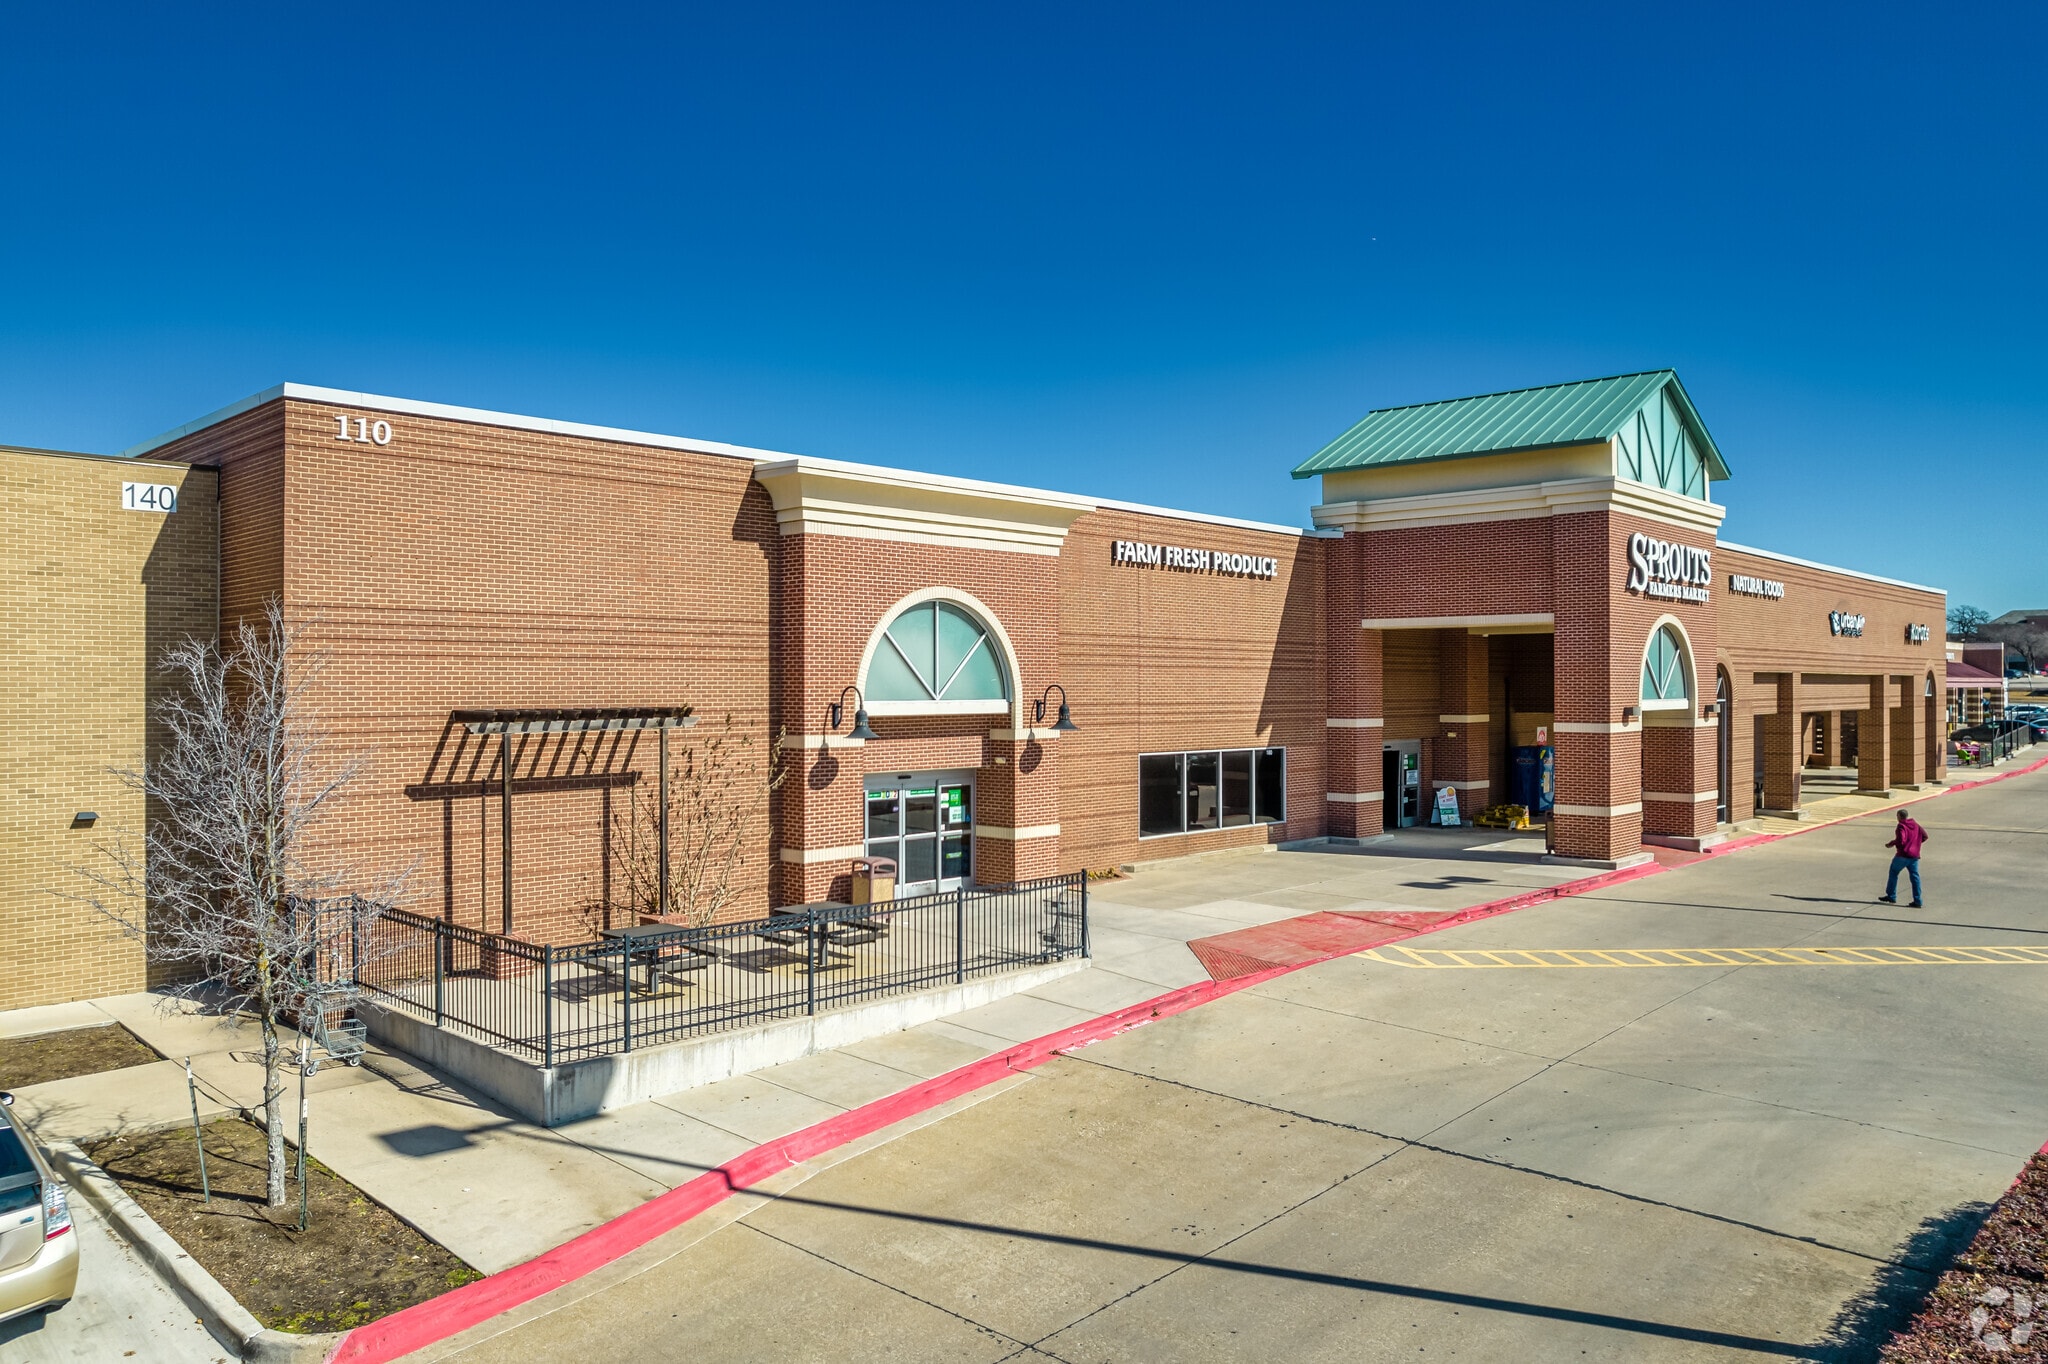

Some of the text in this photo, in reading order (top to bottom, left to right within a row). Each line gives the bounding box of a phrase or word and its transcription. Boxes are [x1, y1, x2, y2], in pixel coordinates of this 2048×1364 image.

[335, 415, 392, 445] 110
[125, 483, 175, 510] 140
[1116, 540, 1278, 576] FARM FRESH PRODUCE
[1649, 581, 1710, 602] FARMERS MARKET
[1733, 574, 1784, 598] NATURAL FOODS
